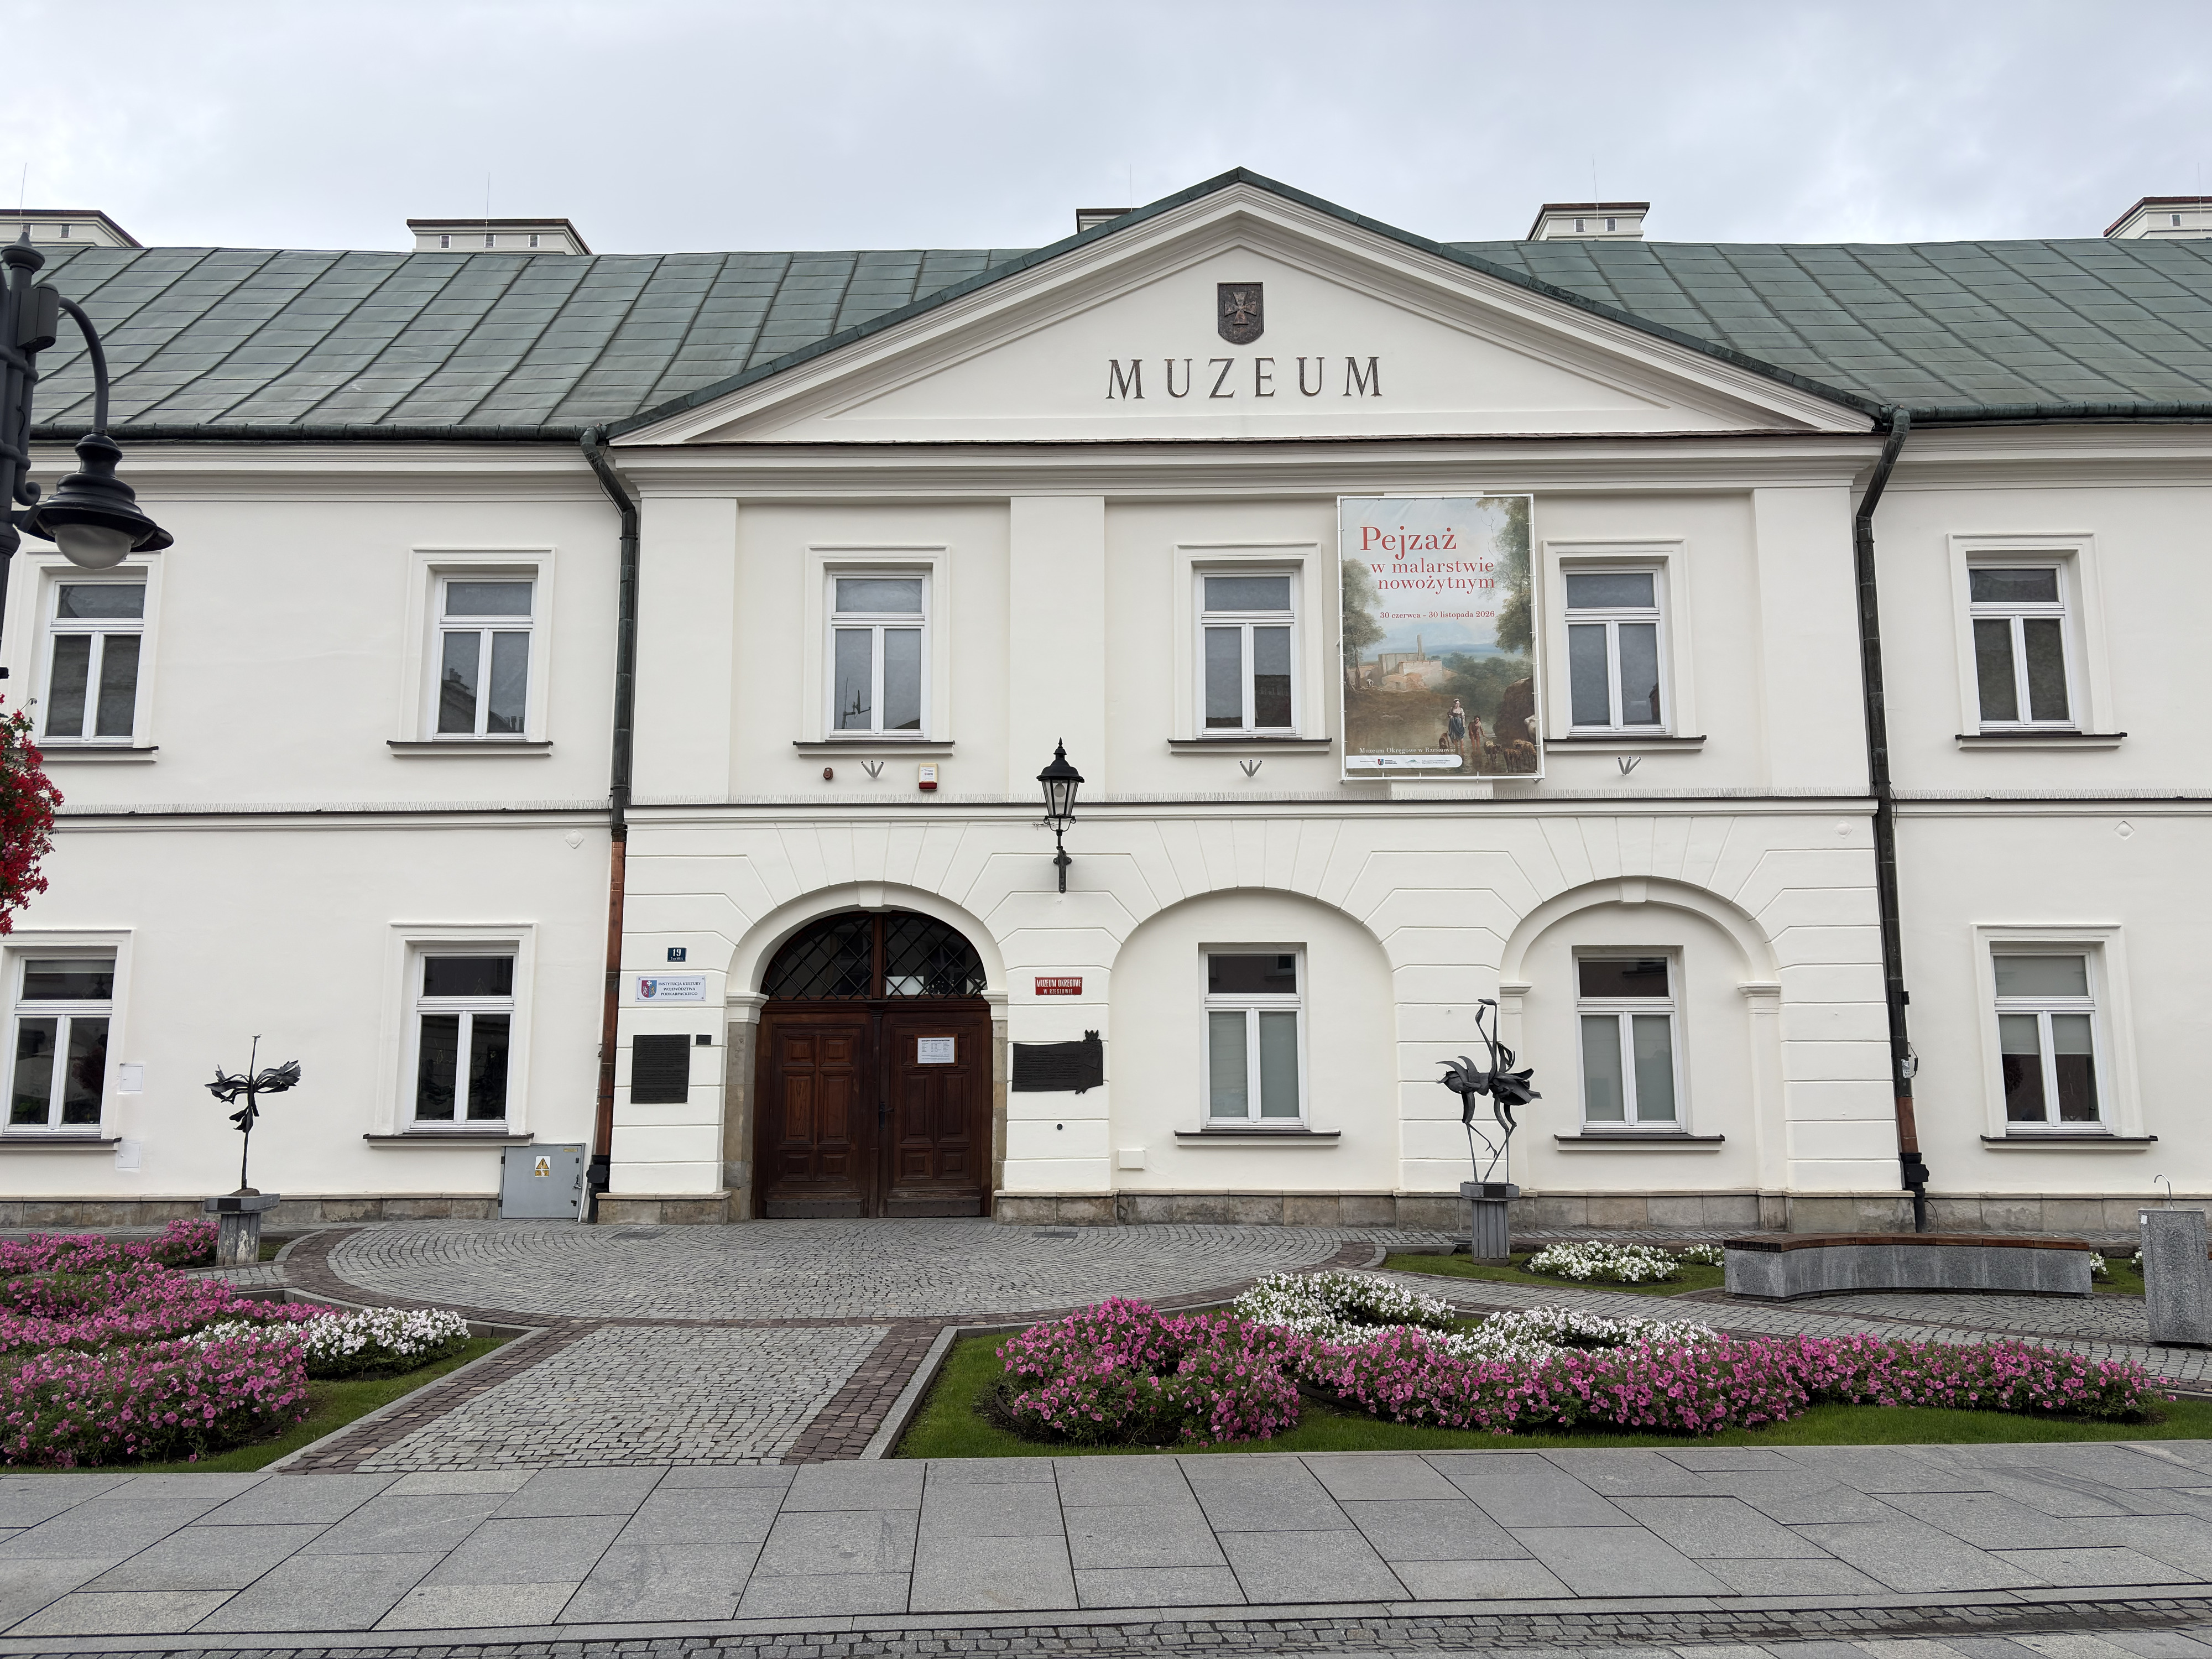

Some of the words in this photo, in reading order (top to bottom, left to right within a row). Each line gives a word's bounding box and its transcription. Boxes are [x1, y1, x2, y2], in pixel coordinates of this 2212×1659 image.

[1105, 356, 1383, 400] MUZEUM
[1360, 526, 1457, 560] Pejzaż
[1370, 564, 1386, 573] w
[1392, 557, 1494, 573] malarstwie
[1378, 575, 1495, 594] nowożytnym
[1440, 611, 1474, 620] listopada
[672, 948, 681, 957] 19
[1058, 979, 1081, 987] OKRĘGOWE
